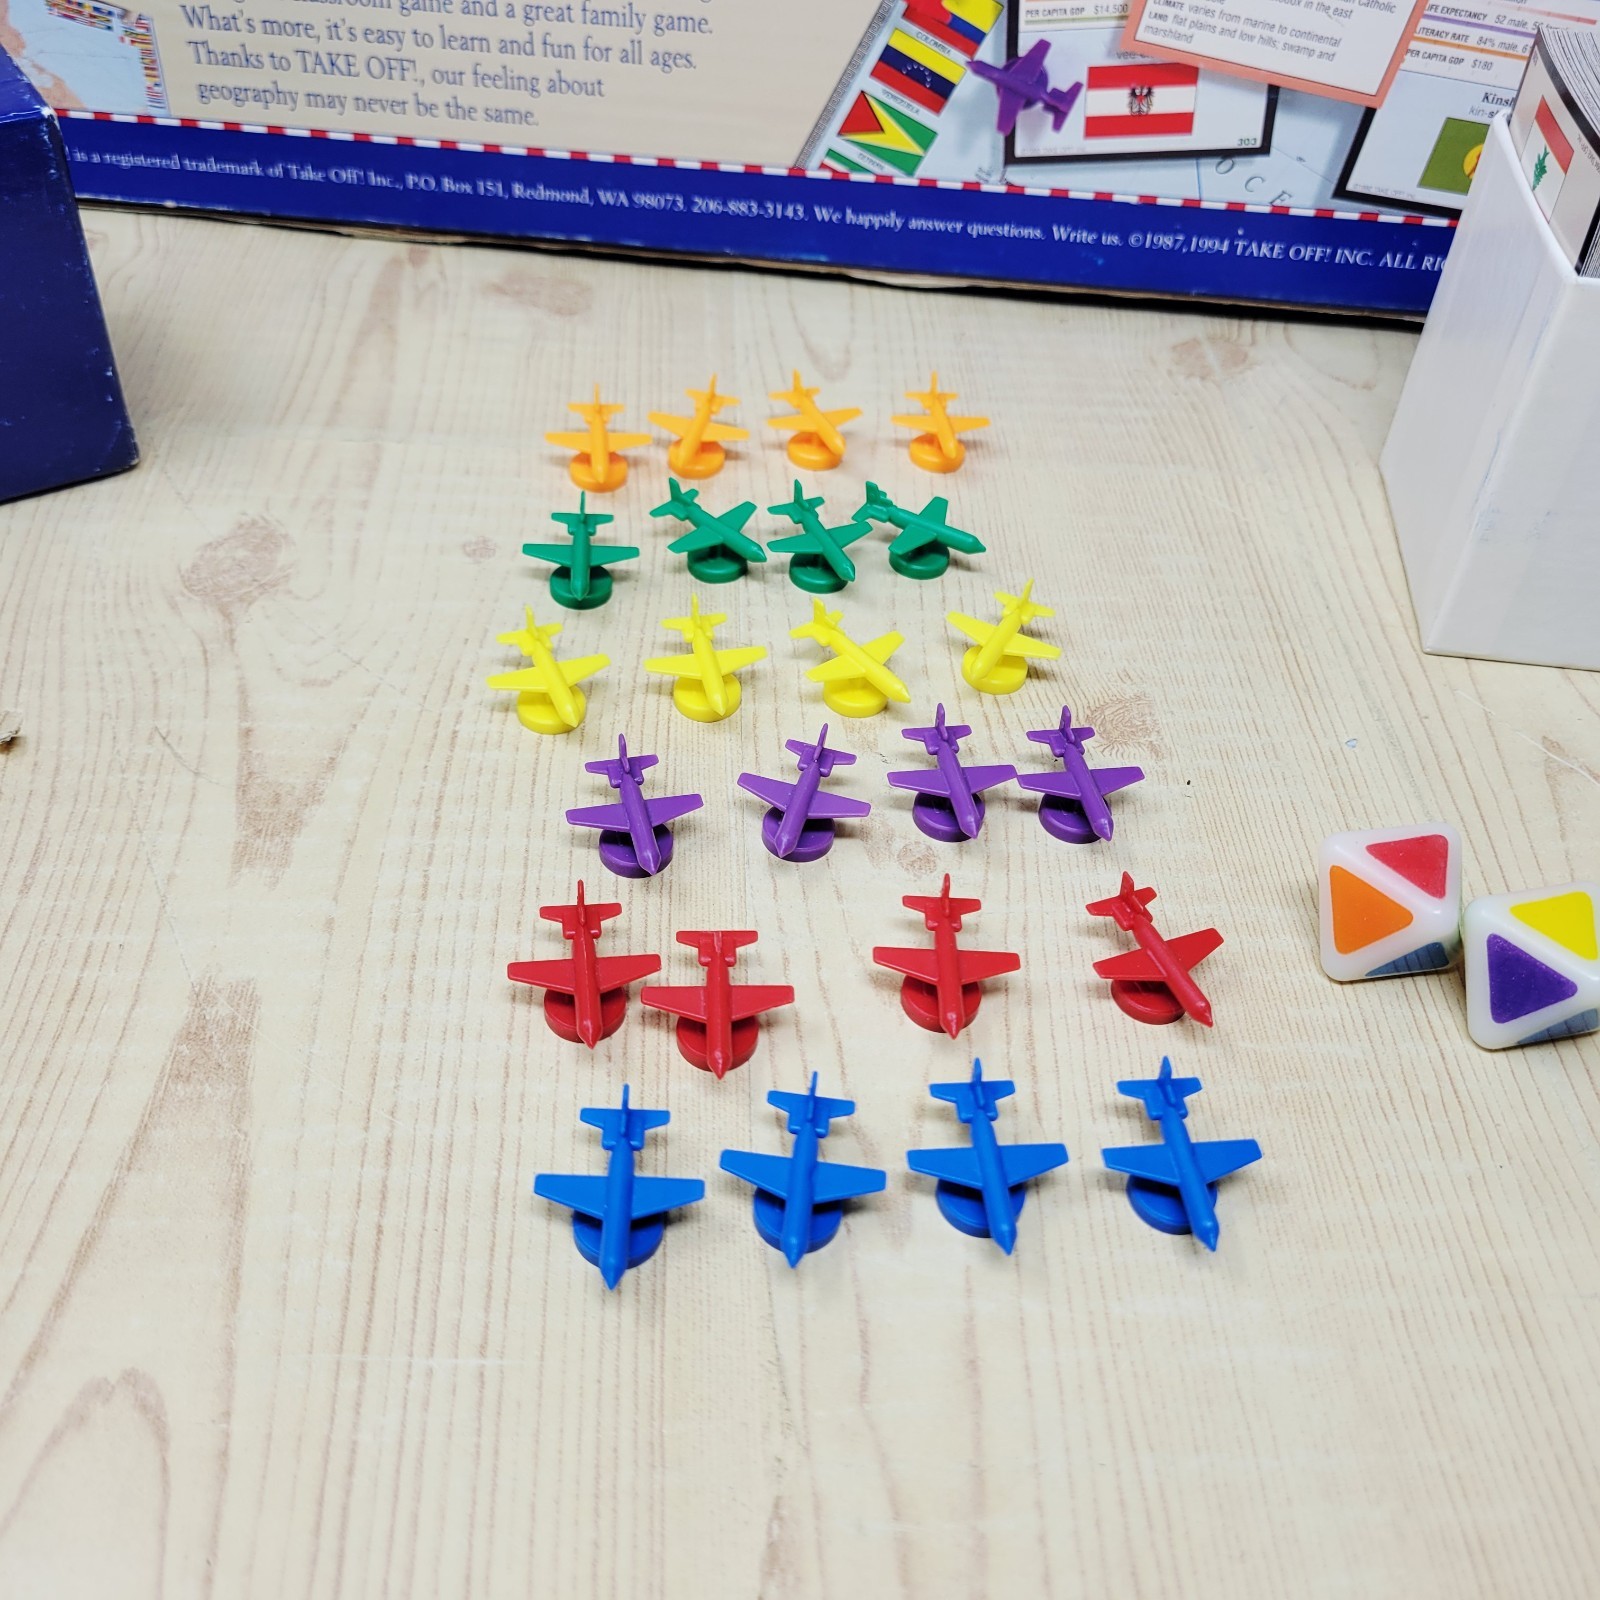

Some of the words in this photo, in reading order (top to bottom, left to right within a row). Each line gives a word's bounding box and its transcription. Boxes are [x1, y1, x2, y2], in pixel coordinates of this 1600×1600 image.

[400, 0, 452, 16] game
[461, 0, 498, 17] and
[506, 5, 516, 18] a
[523, 4, 575, 26] great
[581, 1, 646, 35] family
[654, 13, 713, 36] game.
[1042, 8, 1068, 17] CAPITA
[1316, 2, 1331, 14] the
[1333, 7, 1353, 19] east
[1440, 6, 1488, 21] EXPECTANCY
[1494, 14, 1507, 24] 52
[180, 5, 256, 35] What's
[262, 19, 321, 43] more,
[326, 18, 358, 42] it's
[364, 29, 405, 52] easy
[414, 31, 434, 49] to
[440, 25, 491, 53] learn
[499, 31, 535, 56] and
[543, 33, 576, 60] fun
[583, 35, 612, 62] for
[620, 40, 642, 65] all
[650, 51, 697, 74] ages.
[1144, 24, 1194, 44] marshland
[1172, 14, 1187, 27] flat
[1188, 18, 1216, 34] plains
[1218, 26, 1236, 39] and
[1238, 30, 1256, 43] low
[1281, 41, 1316, 58] swamp
[1317, 51, 1336, 62] and
[1188, 4, 1216, 18] varies
[1218, 9, 1241, 24] from
[1243, 17, 1276, 32] marine
[1277, 24, 1287, 35] to
[1289, 28, 1343, 48] continental
[1450, 32, 1470, 43] RATE
[1476, 36, 1496, 48] 84%
[186, 40, 264, 69] Thanks
[269, 52, 291, 72] to
[294, 50, 360, 77] TAKE
[432, 69, 466, 86] our
[473, 63, 541, 98] feeling
[547, 69, 605, 97] about
[1422, 51, 1447, 62] CAPITA
[1448, 56, 1465, 65] GDP
[1471, 58, 1493, 71] $180
[197, 81, 299, 111] geography
[304, 92, 347, 116] may
[354, 97, 408, 115] never
[413, 93, 439, 118] be
[445, 96, 478, 121] the
[484, 107, 539, 126] same.
[1237, 137, 1257, 146] 303
[73, 149, 88, 162] is
[91, 152, 101, 163] a
[102, 152, 181, 170] registered
[183, 156, 265, 176] trademark
[266, 163, 283, 178] of
[287, 164, 326, 182] Take
[328, 167, 364, 185] Off!
[441, 175, 473, 195] Box
[476, 180, 508, 200] 151,
[511, 181, 594, 207] Redmond,
[597, 189, 629, 207] WA
[632, 192, 688, 212] 98073.
[814, 204, 843, 223] We
[846, 206, 904, 232] happily
[908, 217, 963, 234] answer
[967, 221, 1046, 240] questions.
[1053, 224, 1098, 245] Write
[1102, 231, 1123, 246] us.
[1234, 239, 1285, 260] TAKE
[1289, 245, 1331, 263] OFF!
[1335, 249, 1374, 267] INC.
[1379, 252, 1416, 270] ALL
